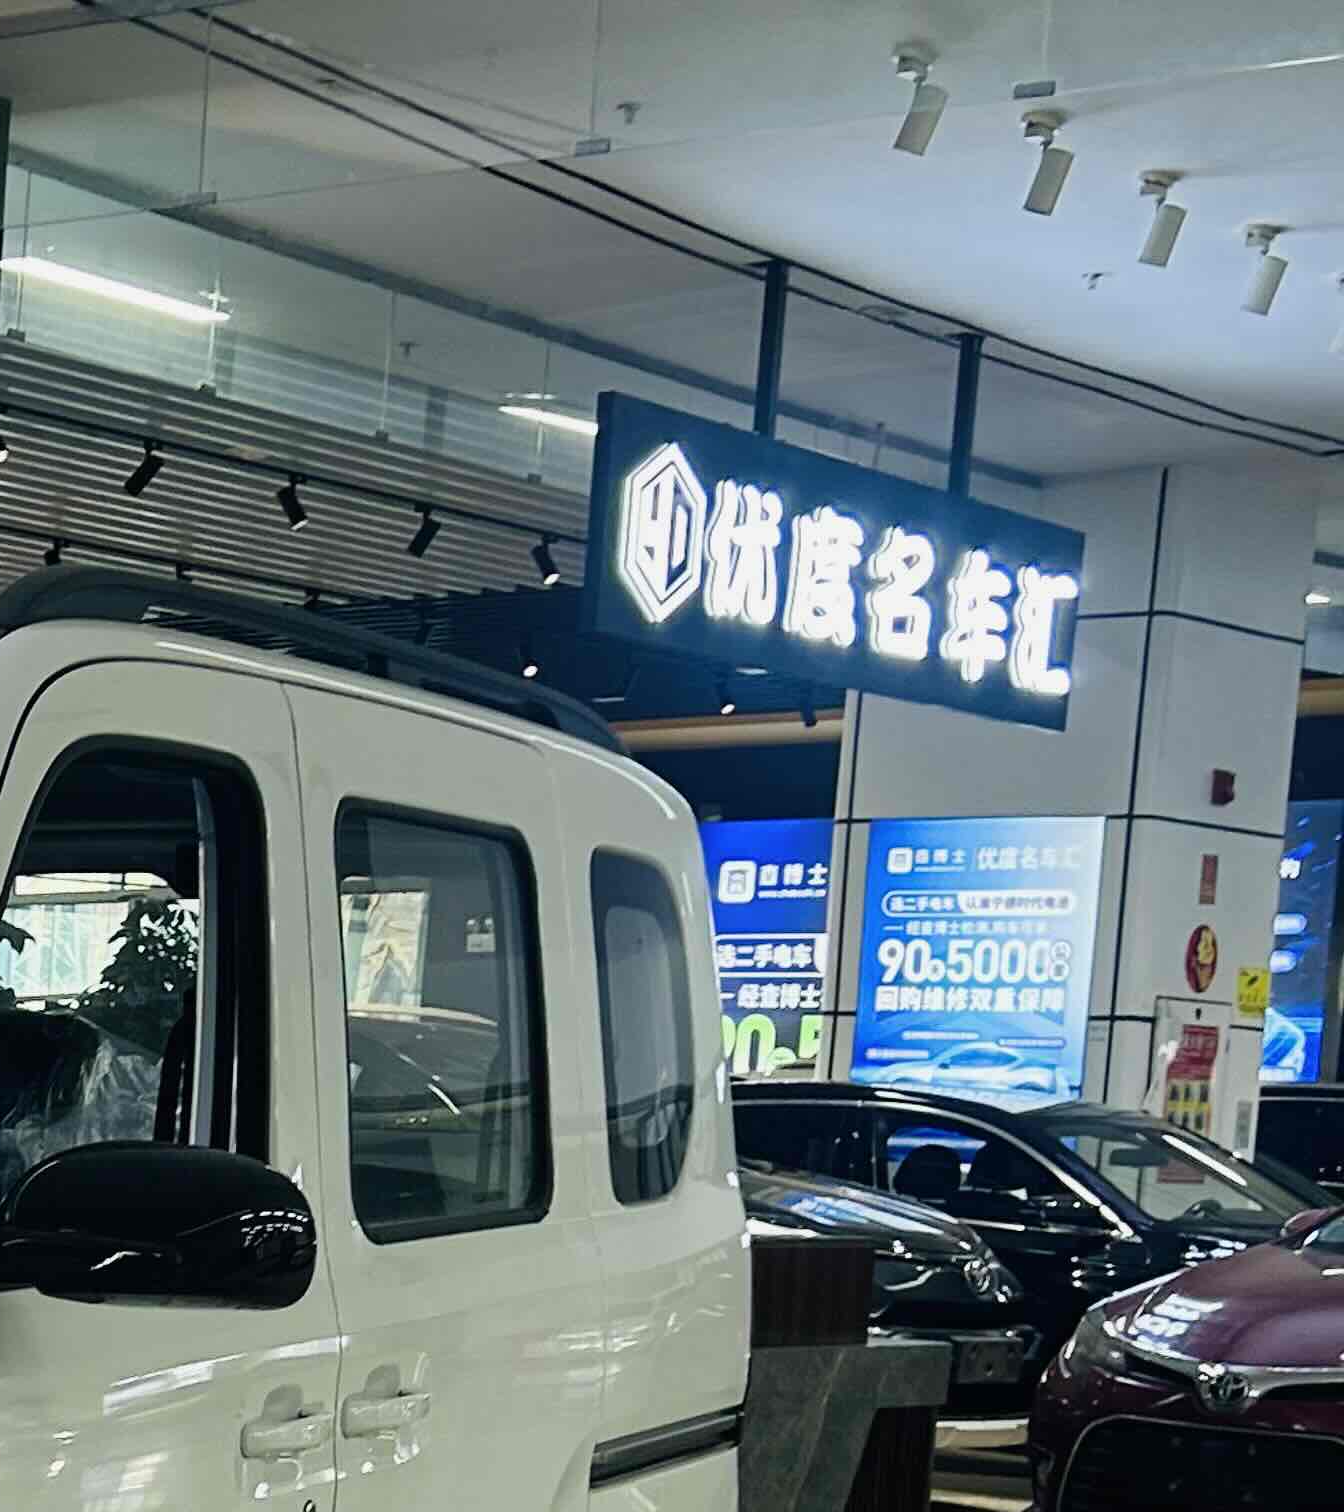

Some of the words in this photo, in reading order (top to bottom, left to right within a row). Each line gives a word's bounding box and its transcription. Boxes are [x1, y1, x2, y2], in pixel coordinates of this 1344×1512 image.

[704, 478, 1079, 696] 优度名车汇
